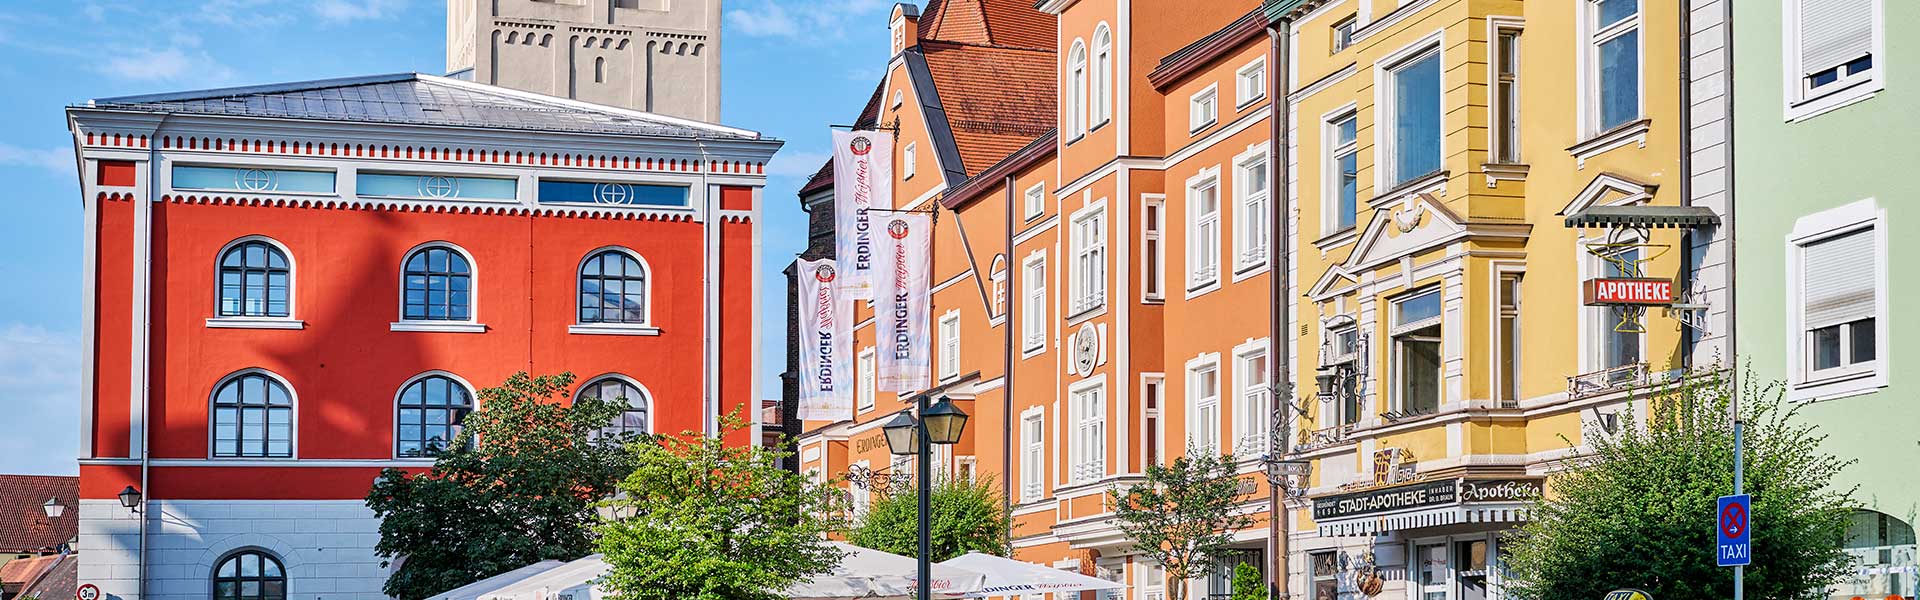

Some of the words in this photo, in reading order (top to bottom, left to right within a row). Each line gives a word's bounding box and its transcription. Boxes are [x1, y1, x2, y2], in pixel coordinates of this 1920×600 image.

[856, 207, 871, 271] ERDINGER
[1597, 282, 1670, 301] APOTHEKE
[895, 292, 910, 360] ERDINGER
[856, 433, 887, 455] ERDINGE
[1463, 481, 1540, 500] Apotheke
[1338, 489, 1426, 514] STADT-APOTHEKE
[1720, 543, 1747, 560] TAXI
[982, 583, 1035, 593] DINGER
